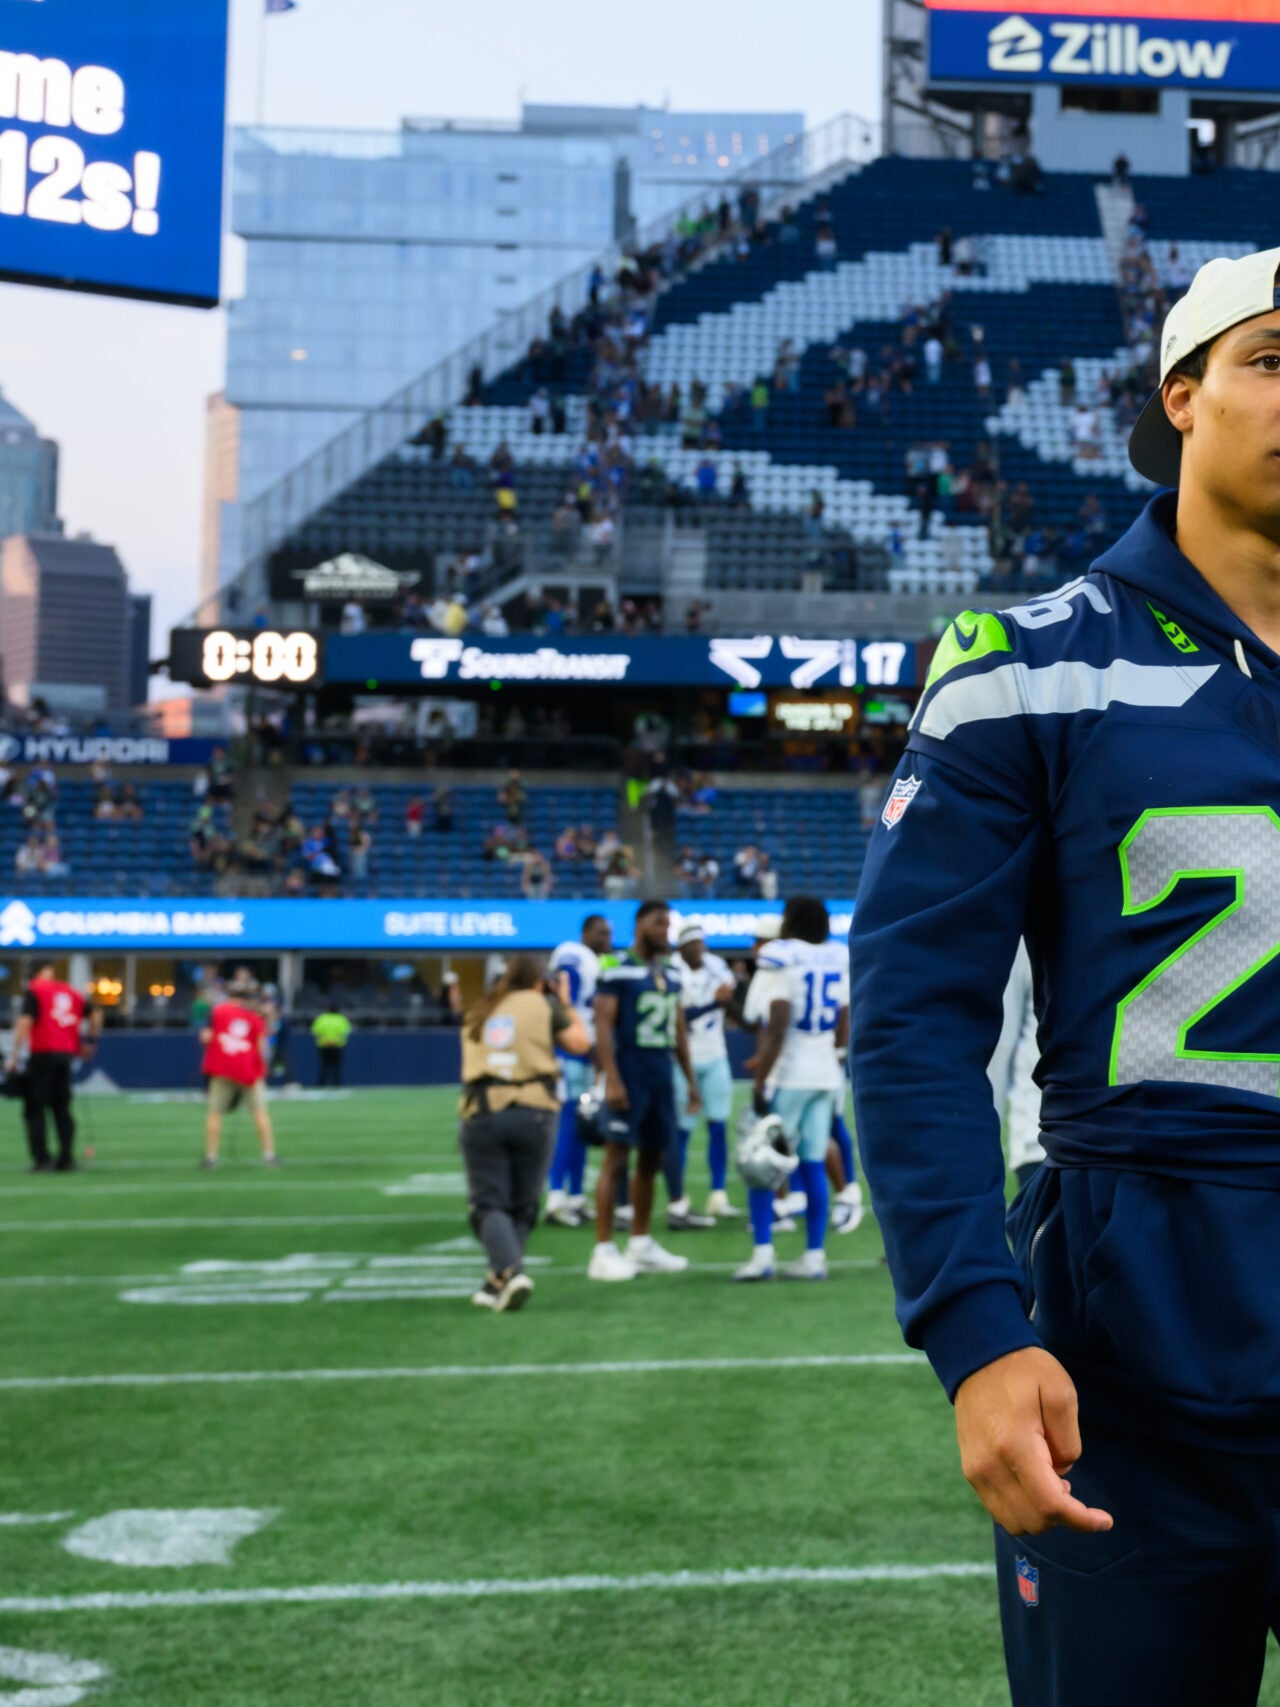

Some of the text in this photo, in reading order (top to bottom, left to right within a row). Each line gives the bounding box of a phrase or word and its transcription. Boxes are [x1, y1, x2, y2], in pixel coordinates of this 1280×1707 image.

[1049, 22, 1232, 79] Zillow
[0, 129, 161, 236] 12s!
[203, 631, 316, 681] 0:00
[861, 642, 907, 685] 17
[171, 911, 244, 935] BANK
[384, 911, 517, 936] SUITE LEVEL
[797, 971, 841, 1032] 15
